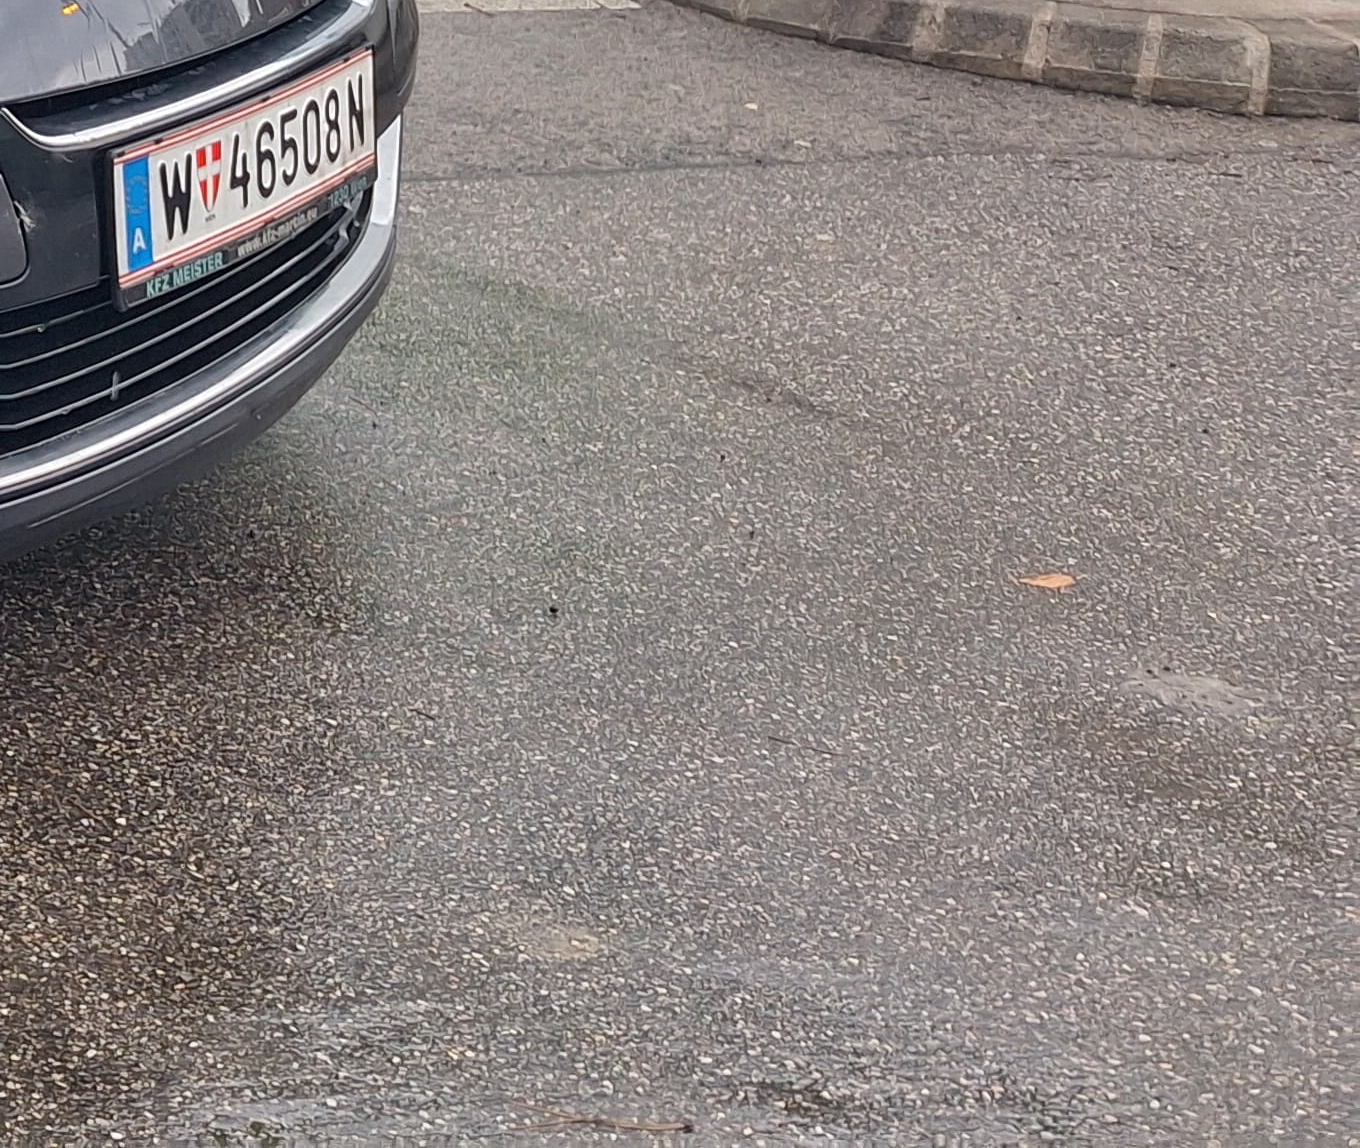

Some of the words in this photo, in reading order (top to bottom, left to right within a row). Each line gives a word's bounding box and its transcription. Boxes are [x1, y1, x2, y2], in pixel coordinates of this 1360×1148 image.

[158, 152, 192, 241] W
[132, 227, 146, 250] A
[146, 273, 170, 299] KFZ
[173, 251, 224, 286] MEISTER
